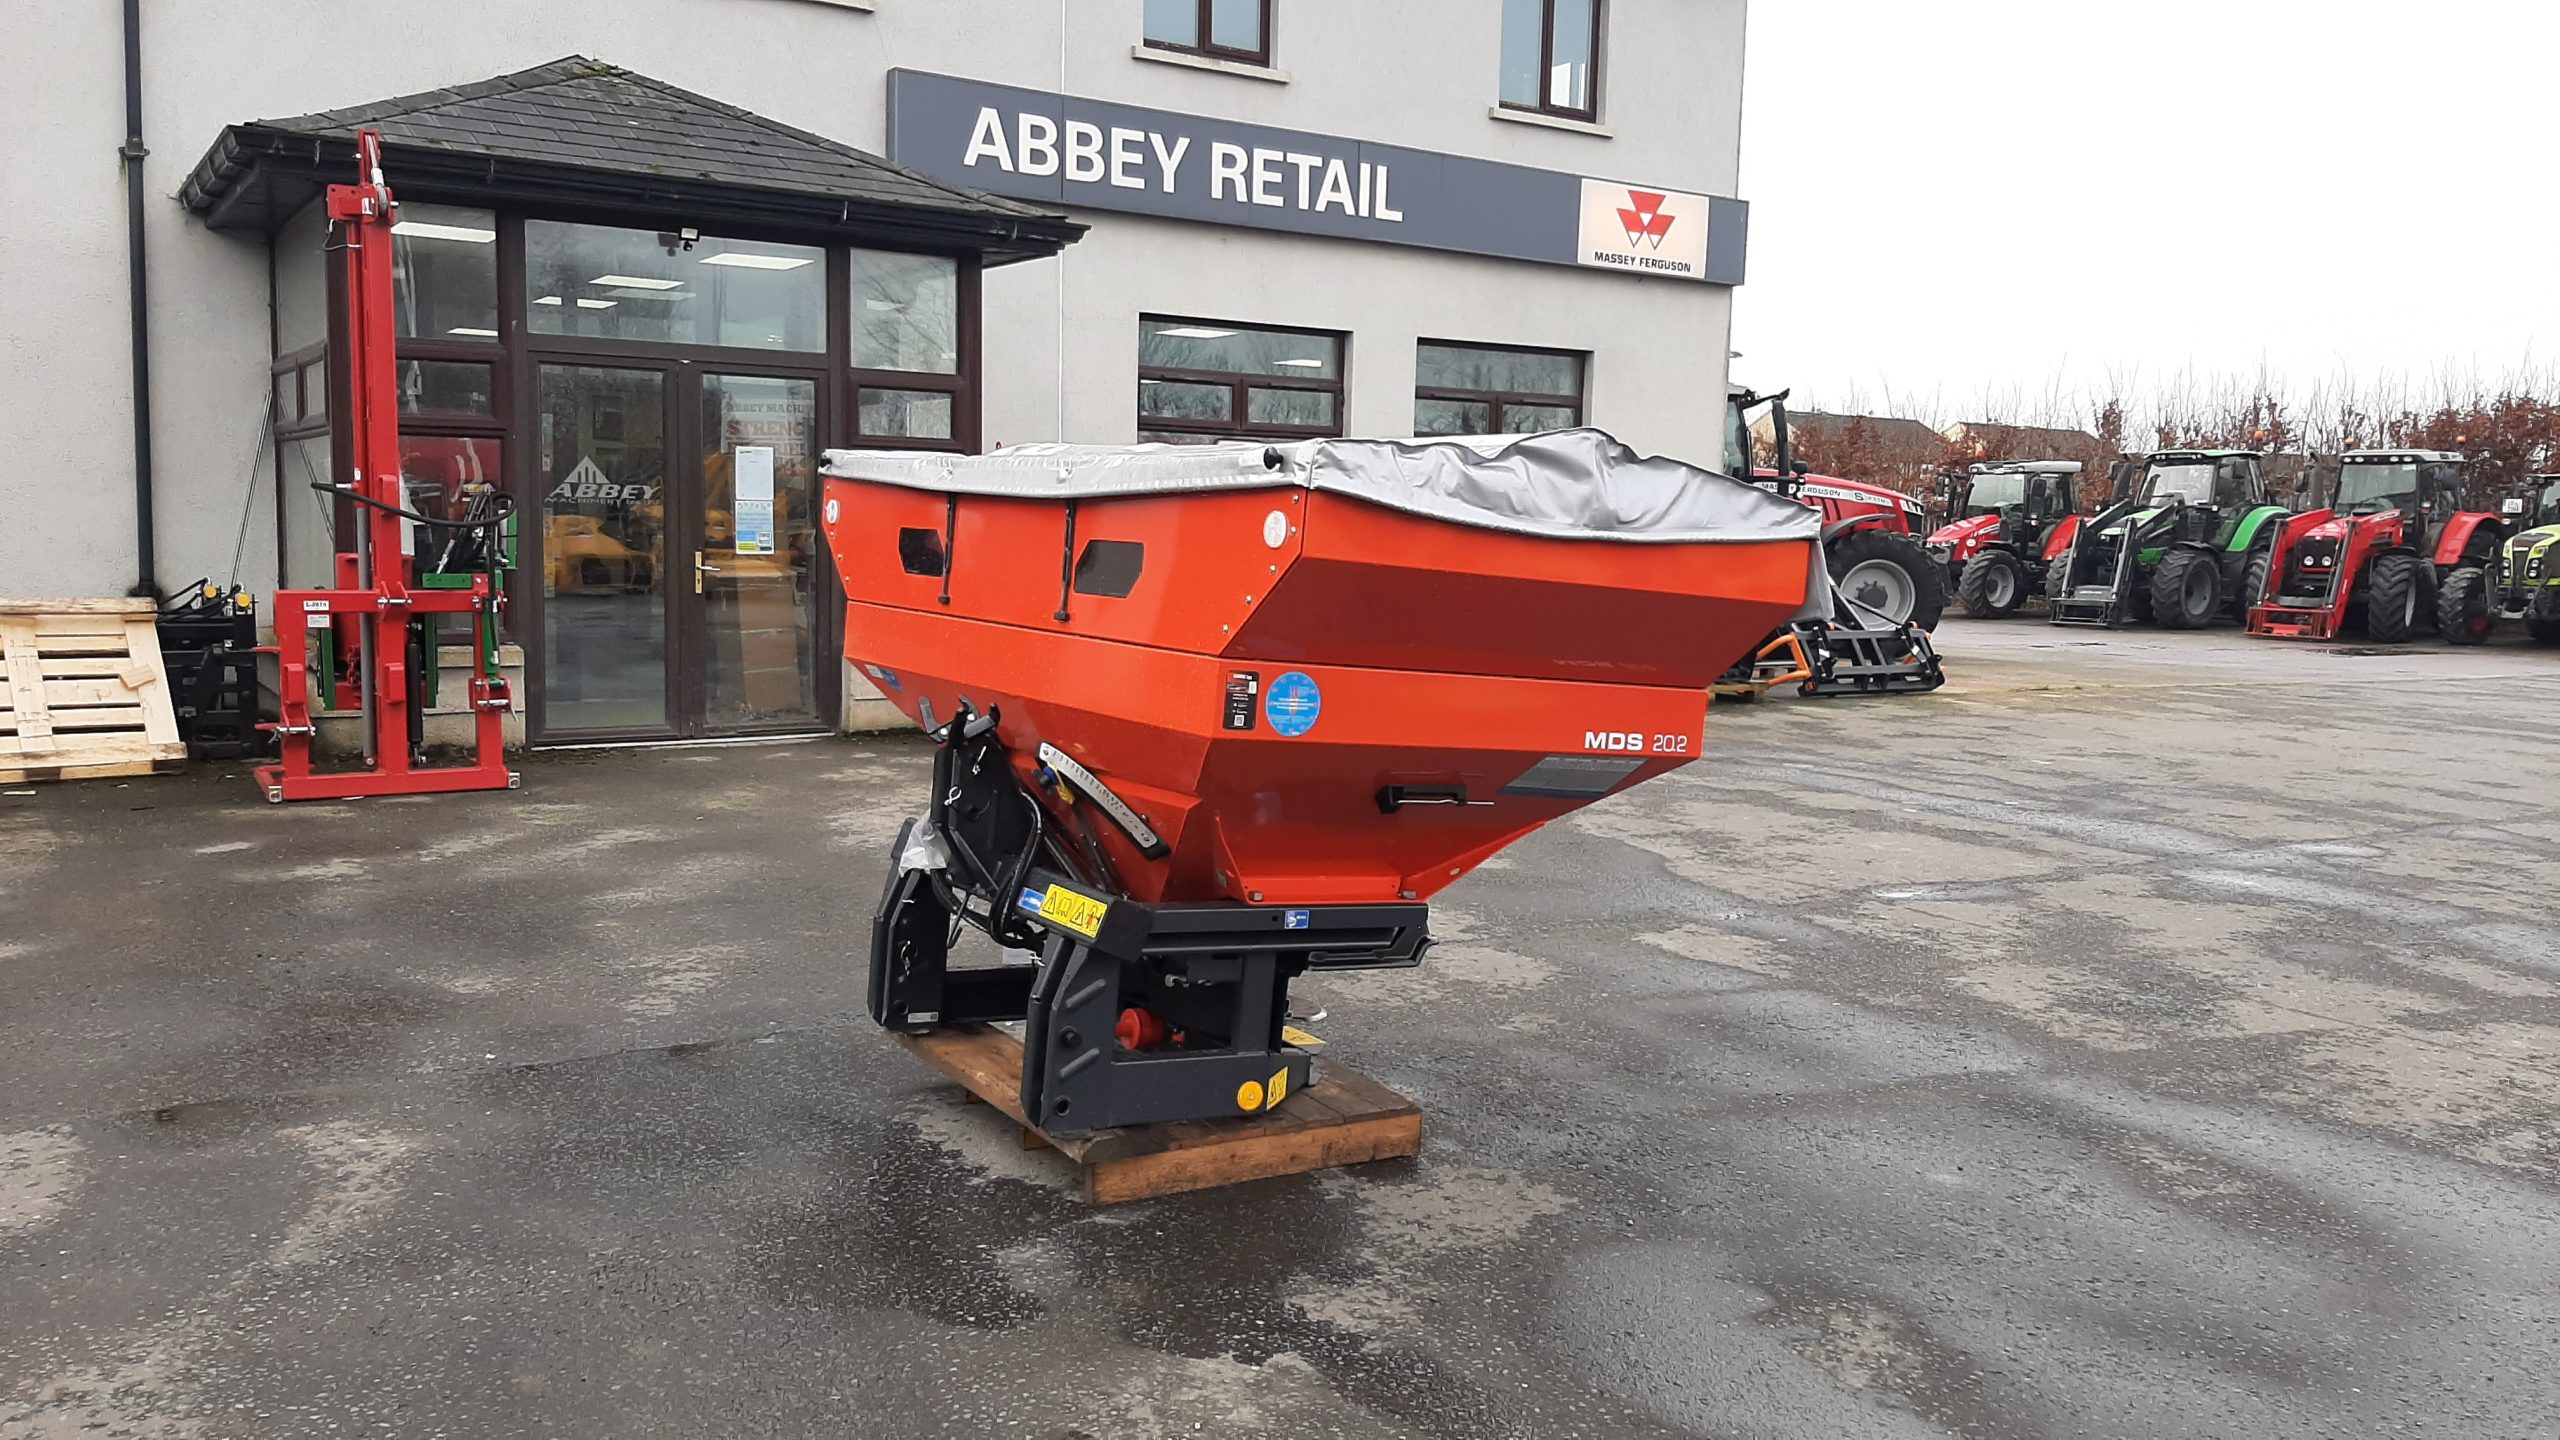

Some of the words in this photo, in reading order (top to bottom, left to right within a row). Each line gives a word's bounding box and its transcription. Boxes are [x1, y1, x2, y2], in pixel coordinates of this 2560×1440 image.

[963, 106, 1191, 194] ABBEY
[1210, 140, 1405, 223] RETAIL
[1593, 250, 1637, 267] MASSEY
[1638, 256, 1692, 274] FERGUSON
[549, 482, 662, 500] ABBEY
[1584, 731, 1644, 751] MDS
